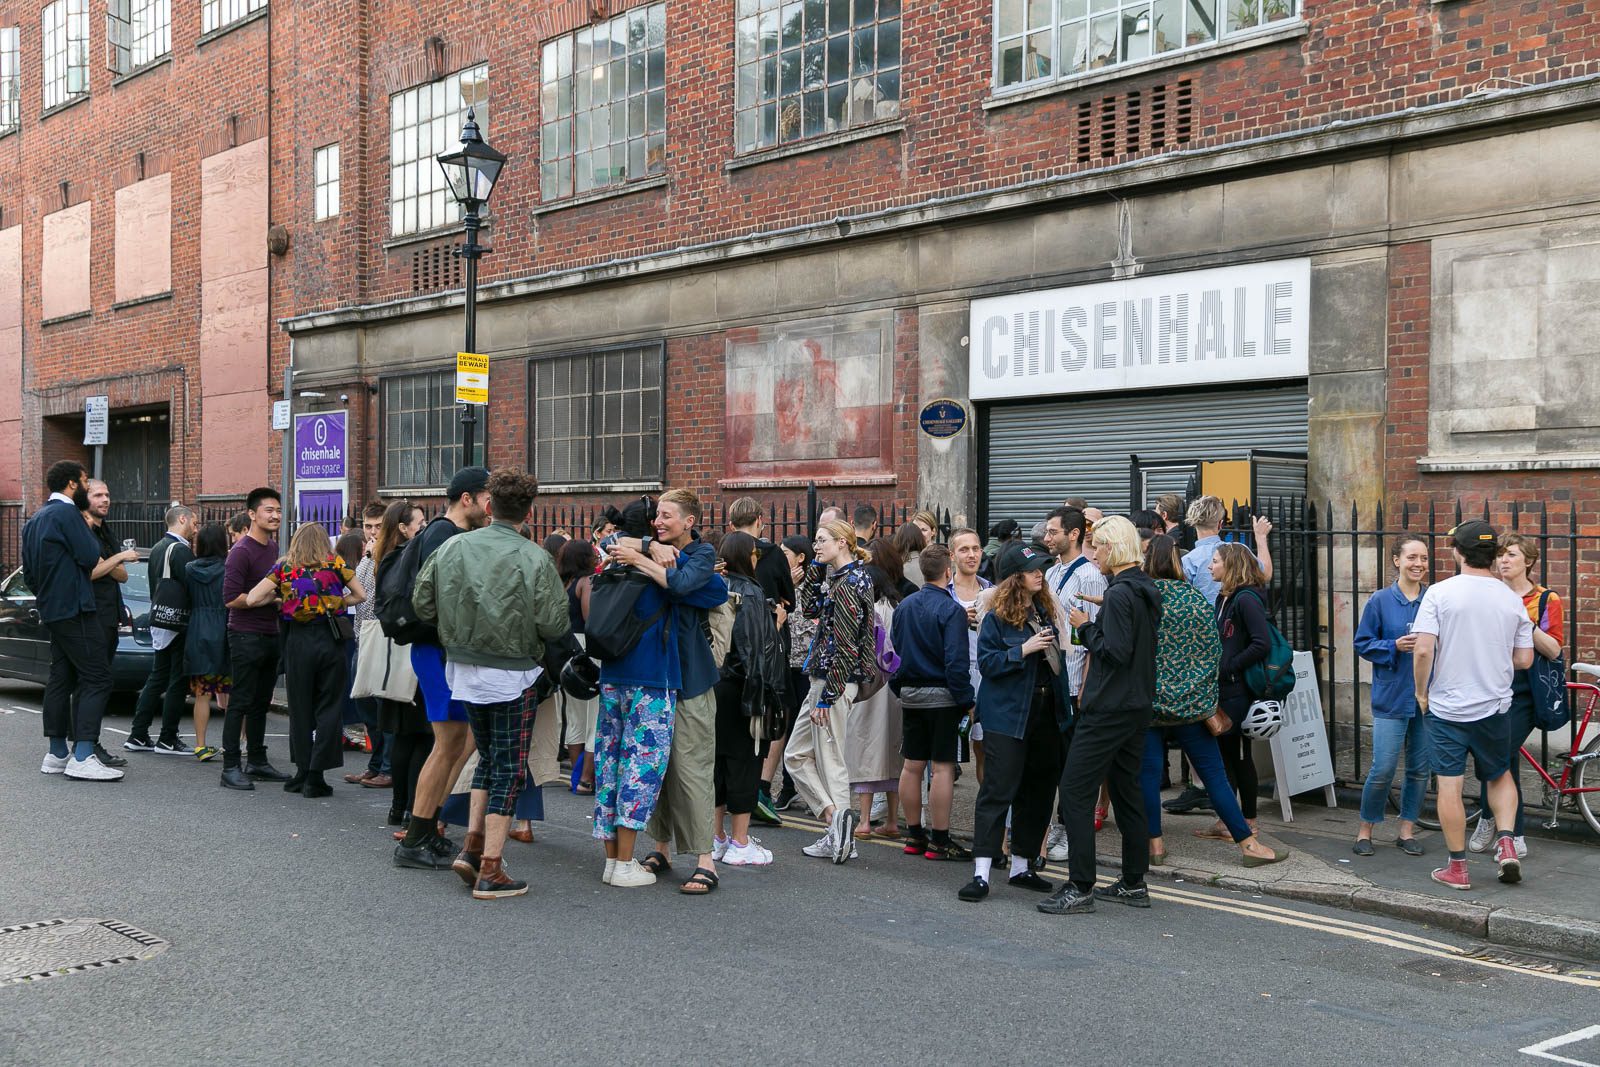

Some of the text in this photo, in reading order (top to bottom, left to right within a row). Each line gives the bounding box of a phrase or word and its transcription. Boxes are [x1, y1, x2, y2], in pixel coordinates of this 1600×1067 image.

[982, 281, 1293, 379] CHISENHALE
[302, 446, 340, 460] chisenhale
[302, 462, 340, 476] dance space
[156, 612, 181, 622] HOUSE
